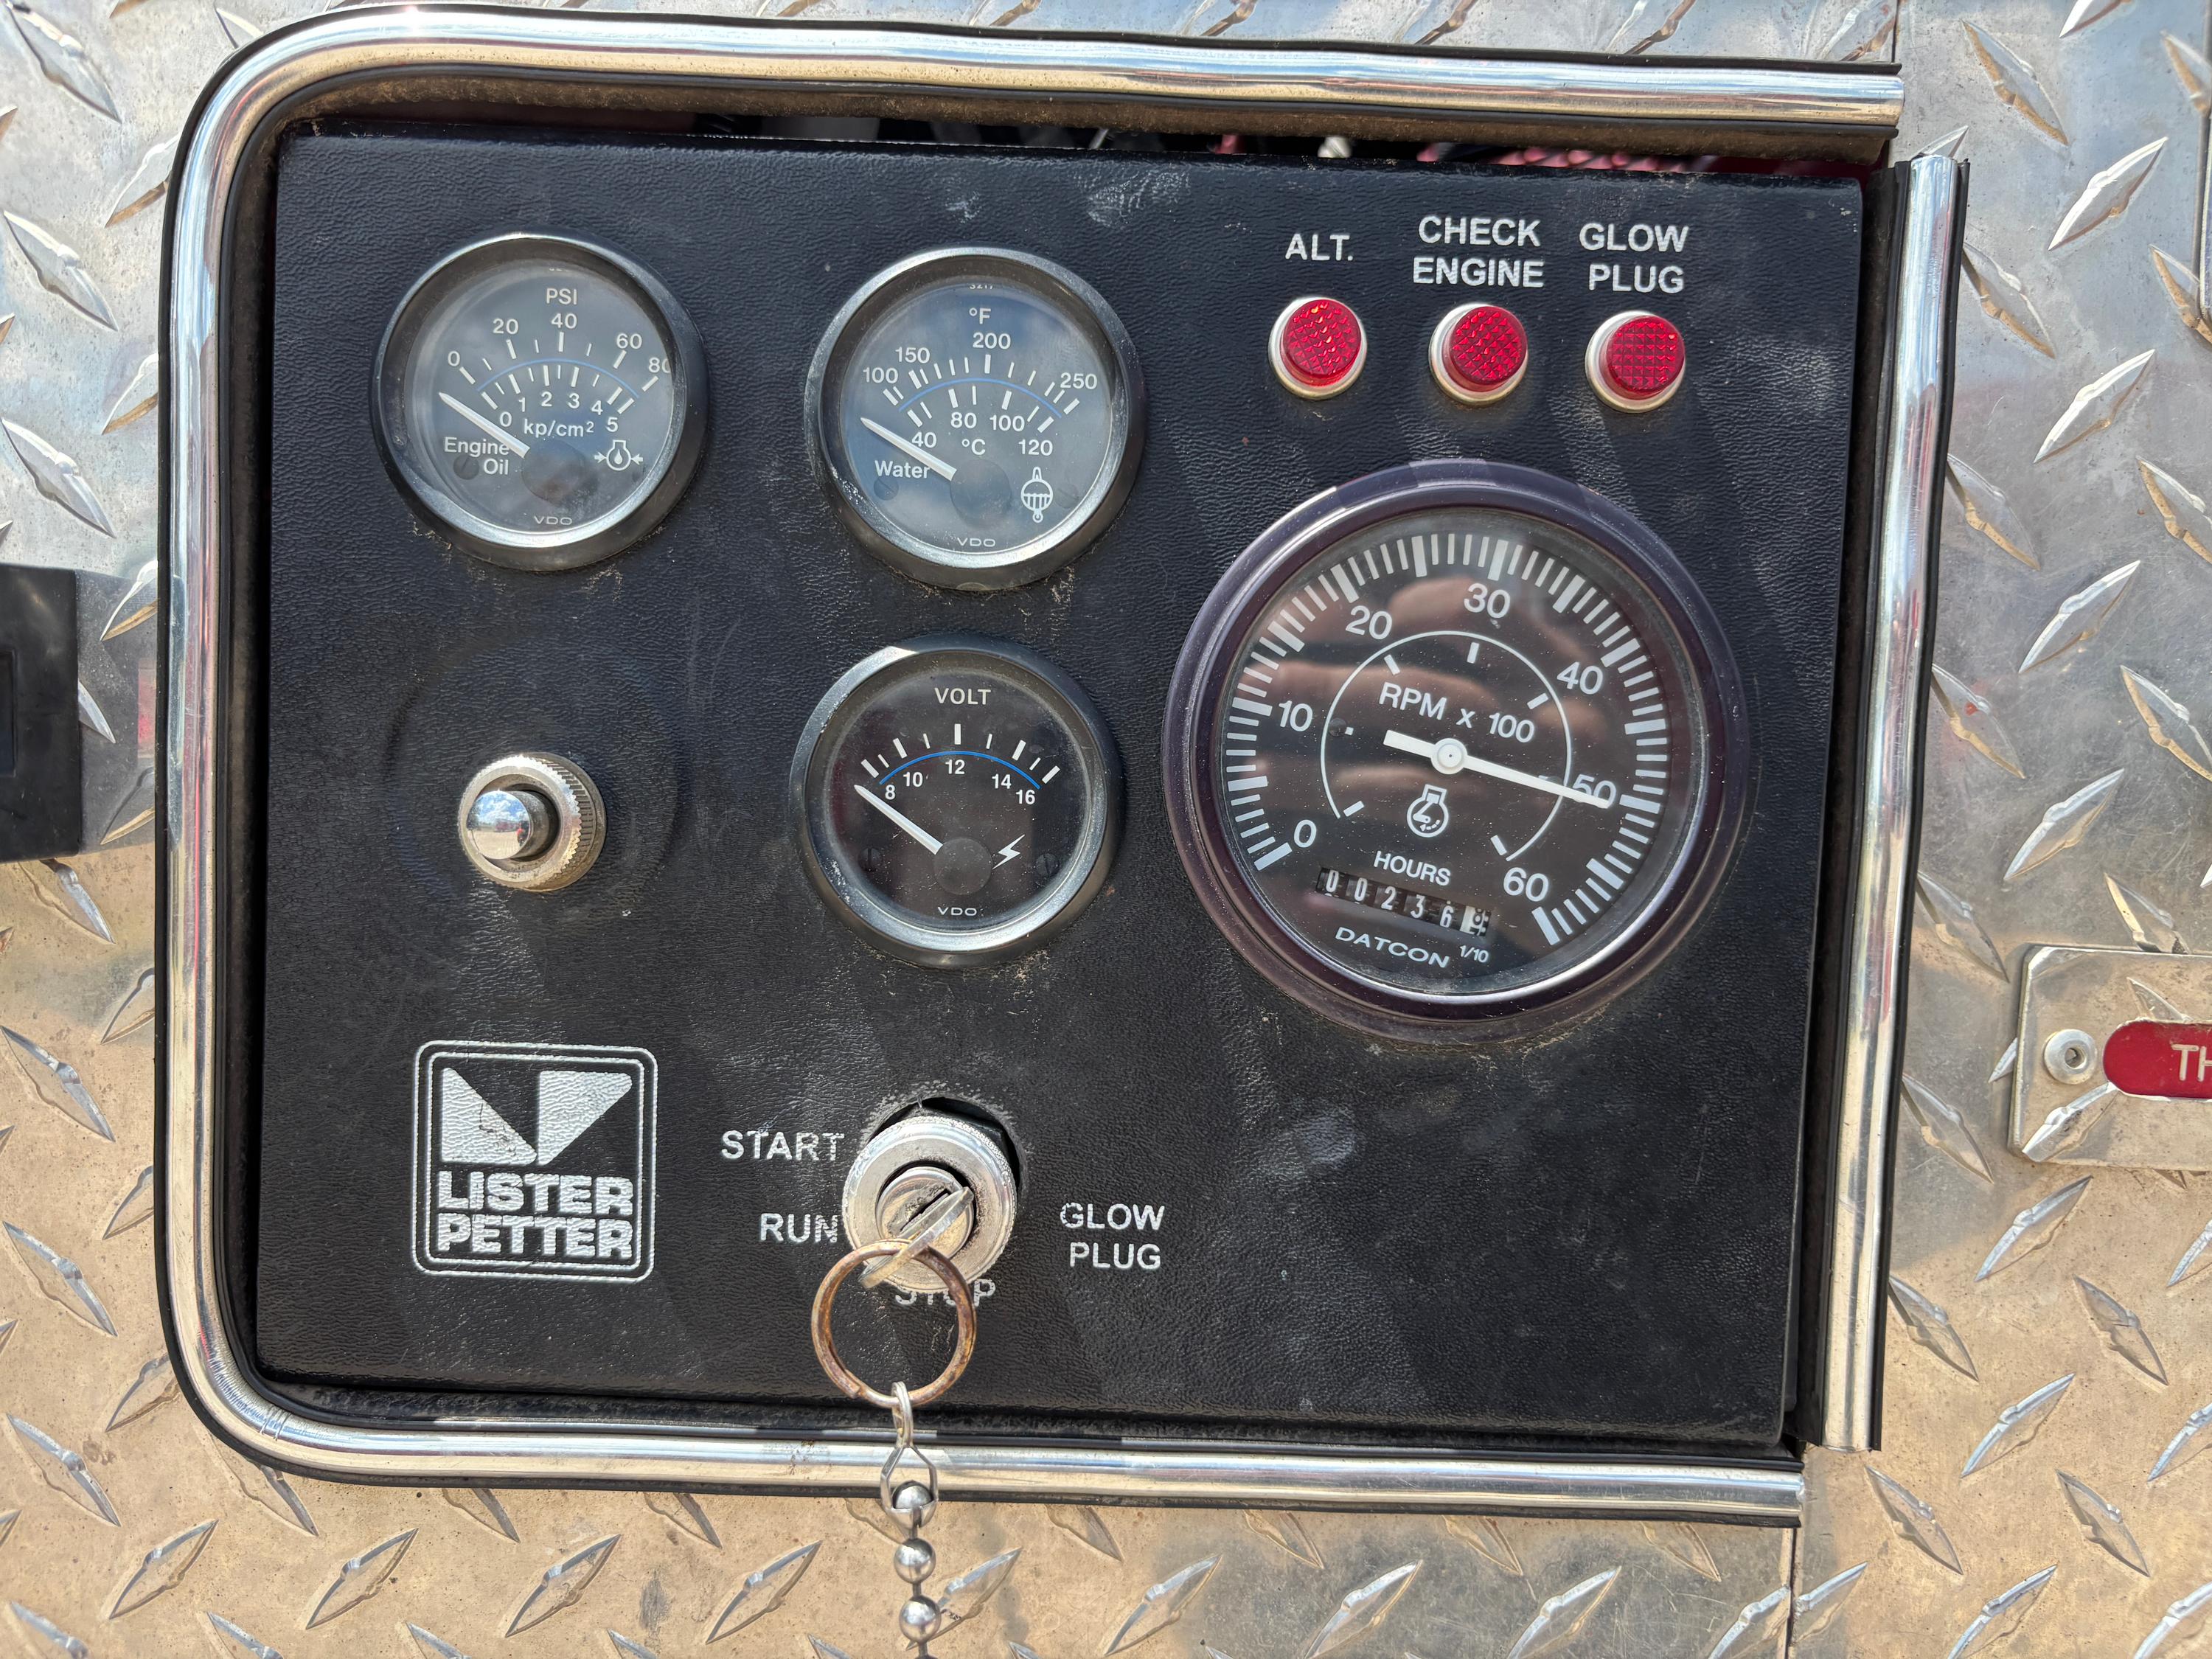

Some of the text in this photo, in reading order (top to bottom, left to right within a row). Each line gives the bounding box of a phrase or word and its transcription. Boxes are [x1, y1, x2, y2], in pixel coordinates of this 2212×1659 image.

[1419, 216, 1540, 246] CHECK
[1579, 223, 1688, 251] GLOW
[1285, 234, 1352, 260] ALT.
[1413, 257, 1543, 287] ENGINE
[1589, 264, 1683, 293] PLUG
[547, 288, 577, 305] PSI
[493, 319, 518, 334] 20
[552, 313, 577, 328] 40
[617, 333, 641, 349] 60
[973, 333, 1010, 349] 200
[448, 351, 460, 366] 0
[896, 347, 930, 363] 150
[649, 358, 669, 372] 80
[863, 367, 898, 383] 100
[1060, 372, 1097, 389] 250
[518, 398, 526, 412] 1
[542, 392, 552, 406] 2
[568, 393, 580, 408] 3
[591, 400, 602, 414] 4
[500, 411, 512, 426] 0
[607, 417, 618, 432] 5
[951, 412, 976, 428] 80
[990, 415, 1024, 431] 100
[445, 437, 510, 457] Engine
[912, 432, 937, 449] 40
[1019, 439, 1052, 456] 120
[484, 459, 508, 474] Oil
[875, 460, 931, 479] Water
[534, 516, 572, 525] VDO
[957, 538, 995, 546] VDO
[1464, 583, 1511, 618] 30
[1346, 605, 1392, 639] 20
[1557, 661, 1603, 695] 40
[935, 688, 991, 704] VOLT
[1279, 700, 1312, 731] 10
[1379, 682, 1534, 742] RPM x 100
[945, 759, 964, 774] 12
[903, 772, 922, 787] 10
[992, 774, 1011, 789] 14
[886, 785, 895, 799] 8
[1016, 790, 1034, 804] 16
[1294, 820, 1316, 847] 0
[1374, 851, 1450, 886] HOURS
[1503, 867, 1548, 901] 60
[938, 907, 976, 916] VDO
[1335, 927, 1449, 968] DATCON
[1460, 945, 1489, 962] 1/10
[722, 1129, 844, 1161] START
[439, 1171, 633, 1216] LISTER
[1060, 1203, 1164, 1230] GLOW
[438, 1213, 633, 1258] PETTER
[761, 1214, 838, 1242] RUN
[1070, 1242, 1161, 1269] PLUG
